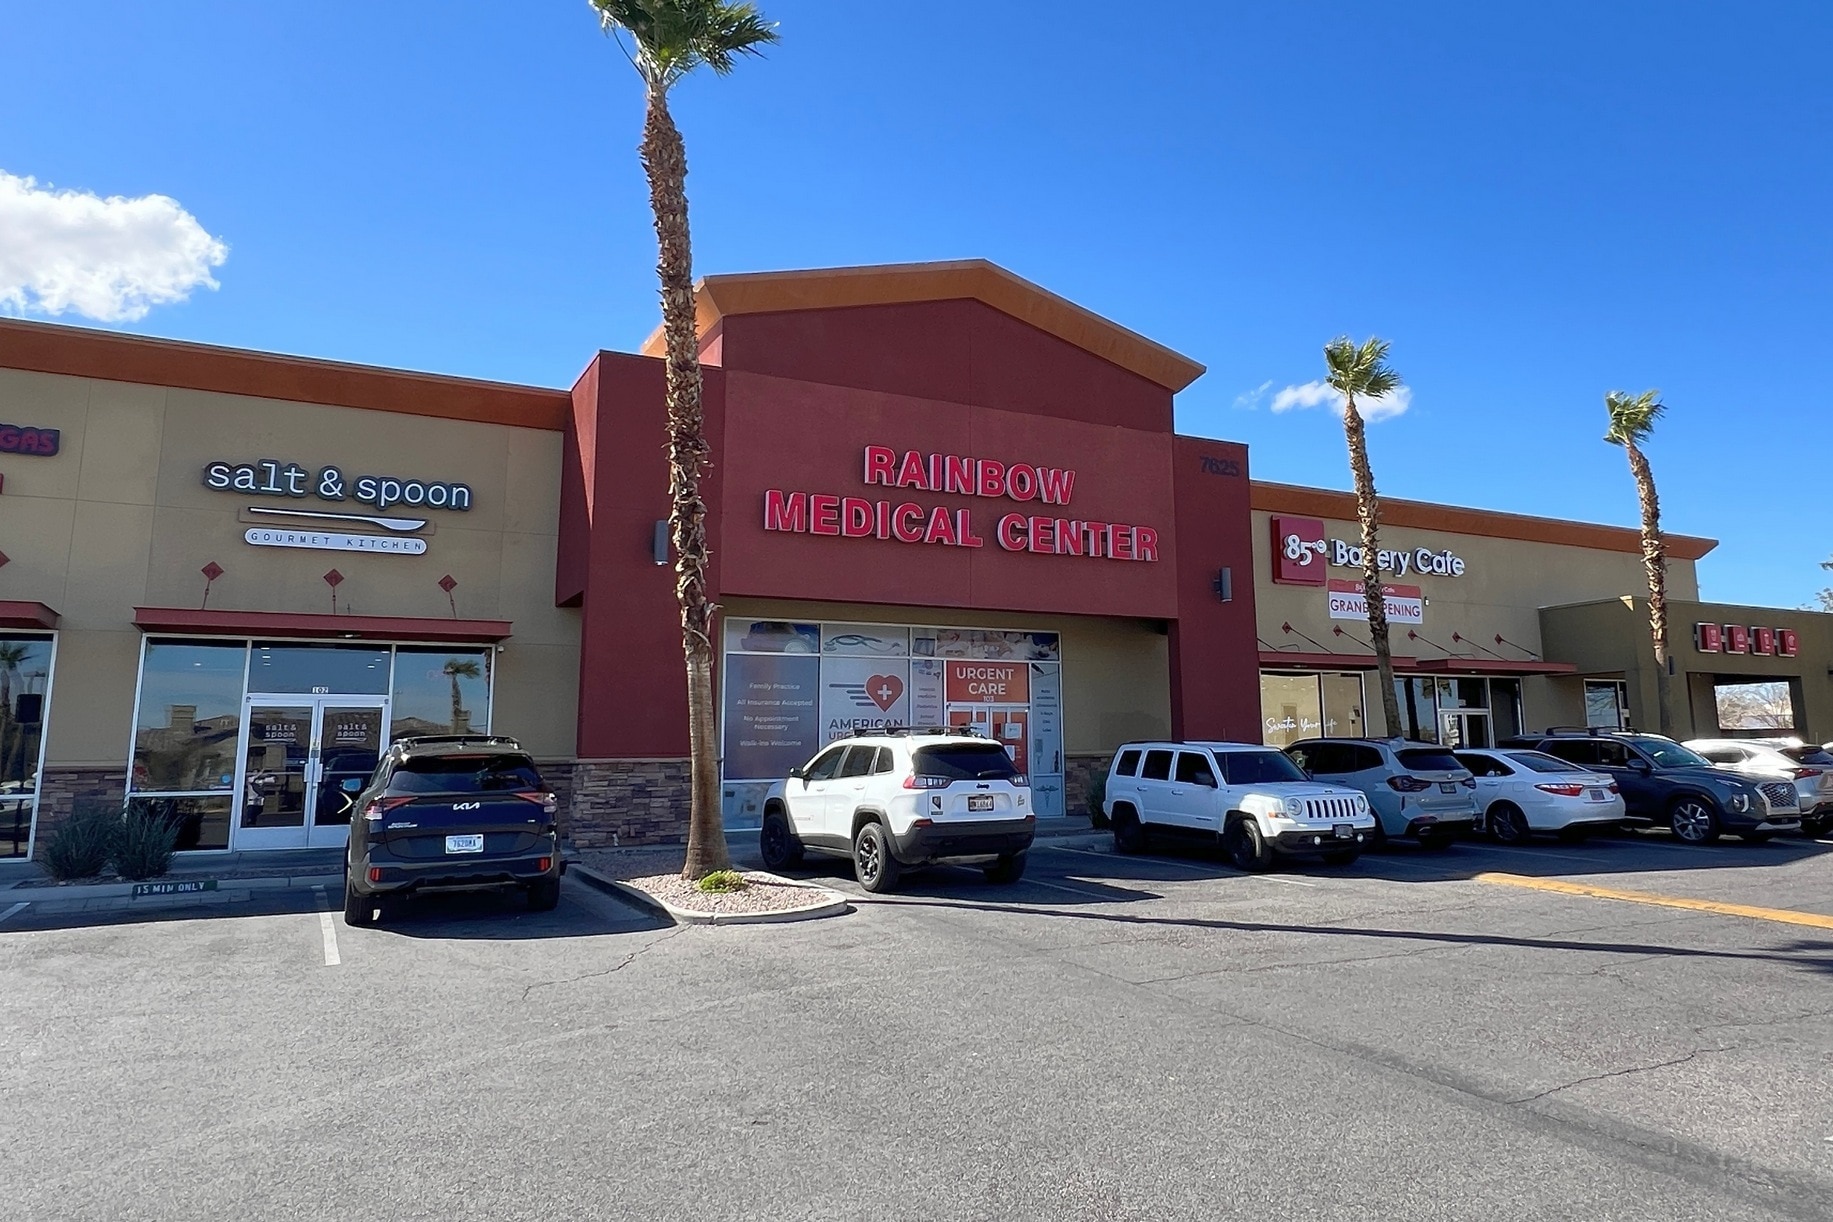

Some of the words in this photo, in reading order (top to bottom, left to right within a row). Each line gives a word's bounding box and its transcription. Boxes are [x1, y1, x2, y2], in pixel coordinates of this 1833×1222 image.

[1199, 456, 1240, 477] 7625
[863, 445, 1077, 505] RAINBOW
[207, 462, 306, 494] salt
[318, 469, 343, 497] &
[356, 478, 470, 507] spoon
[764, 489, 984, 548] MEDICAL
[997, 512, 1159, 562] CENTER
[250, 532, 331, 546] GOURMET
[346, 538, 422, 551] KITCHEN
[1330, 538, 1410, 577] Baery
[1411, 546, 1466, 577] Cafe
[1382, 603, 1420, 617] PENING
[956, 667, 1015, 680] URGENT
[968, 682, 1006, 695] CARE
[265, 723, 289, 731] salt
[829, 718, 903, 730] AMERICAN
[152, 884, 174, 893] MIN
[177, 881, 205, 892] ONLY
